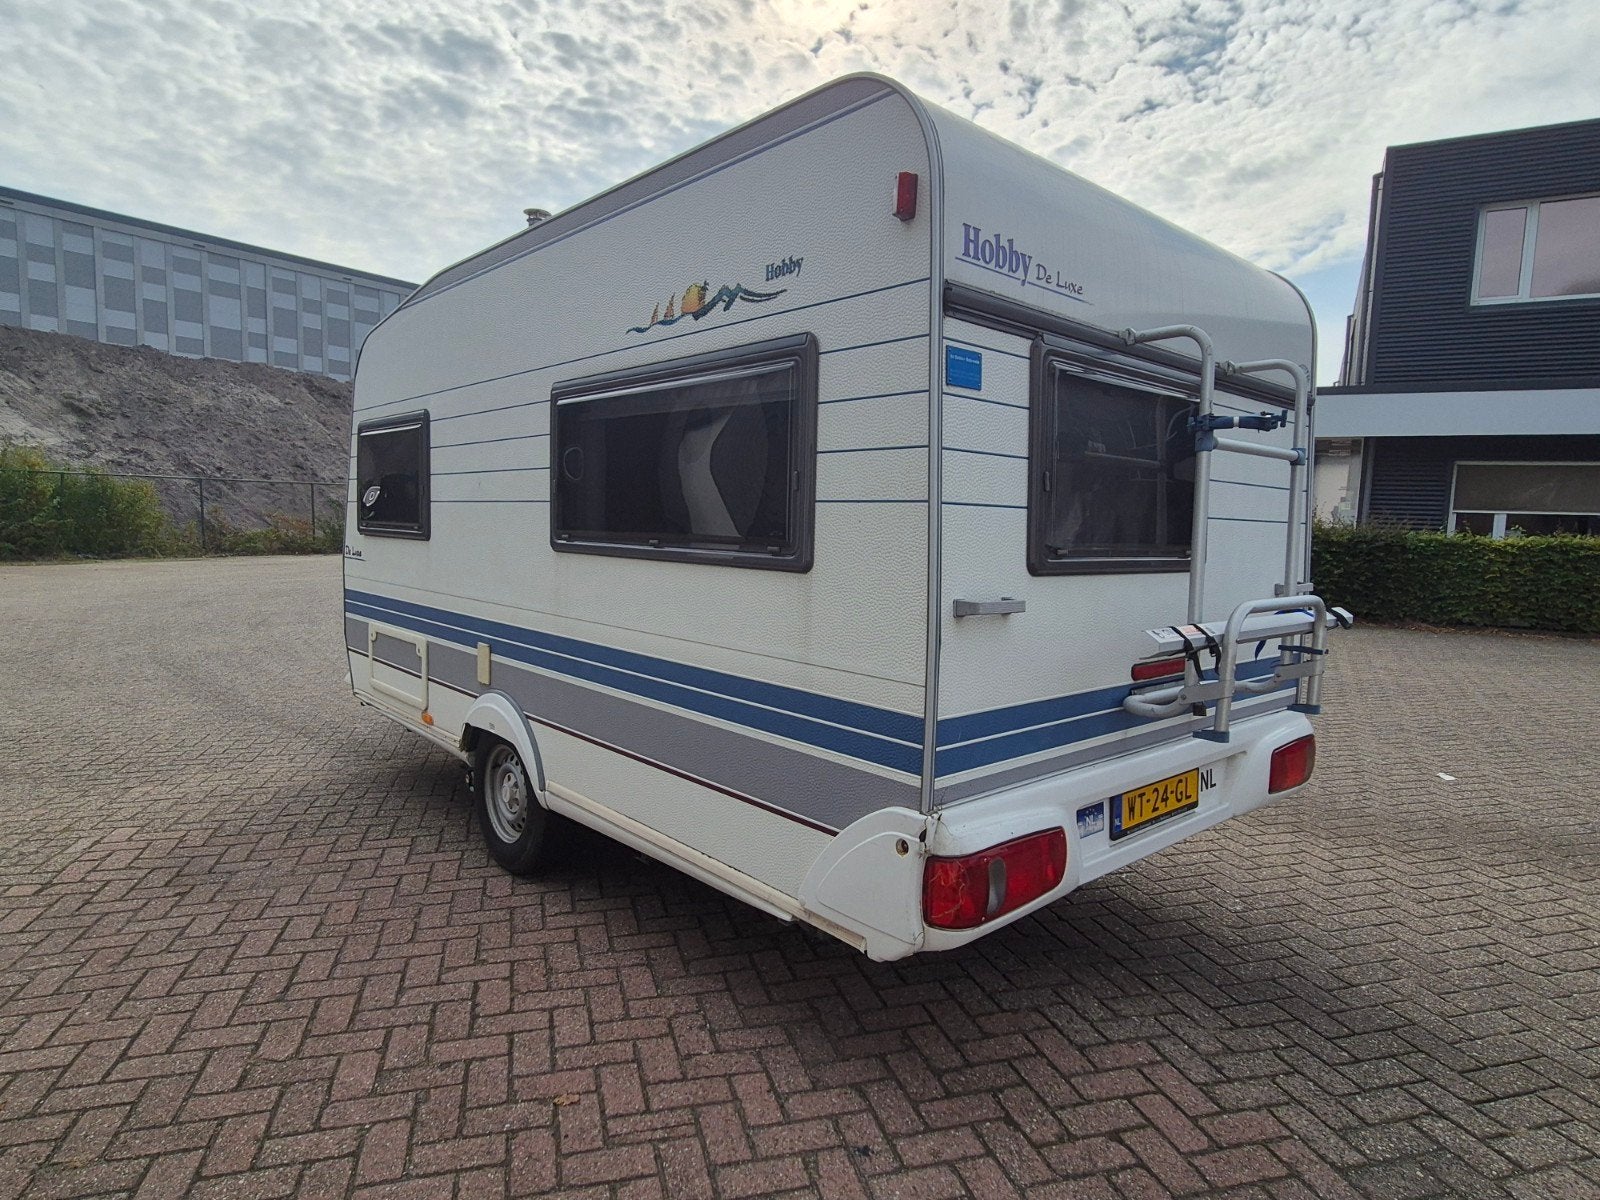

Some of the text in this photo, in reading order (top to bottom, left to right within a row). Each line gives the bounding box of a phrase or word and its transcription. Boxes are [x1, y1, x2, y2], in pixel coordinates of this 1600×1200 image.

[765, 254, 804, 281] Hobby
[962, 222, 1083, 295] Hobby De Luxe
[1200, 768, 1217, 792] NL
[1127, 777, 1192, 821] WT-24-GL
